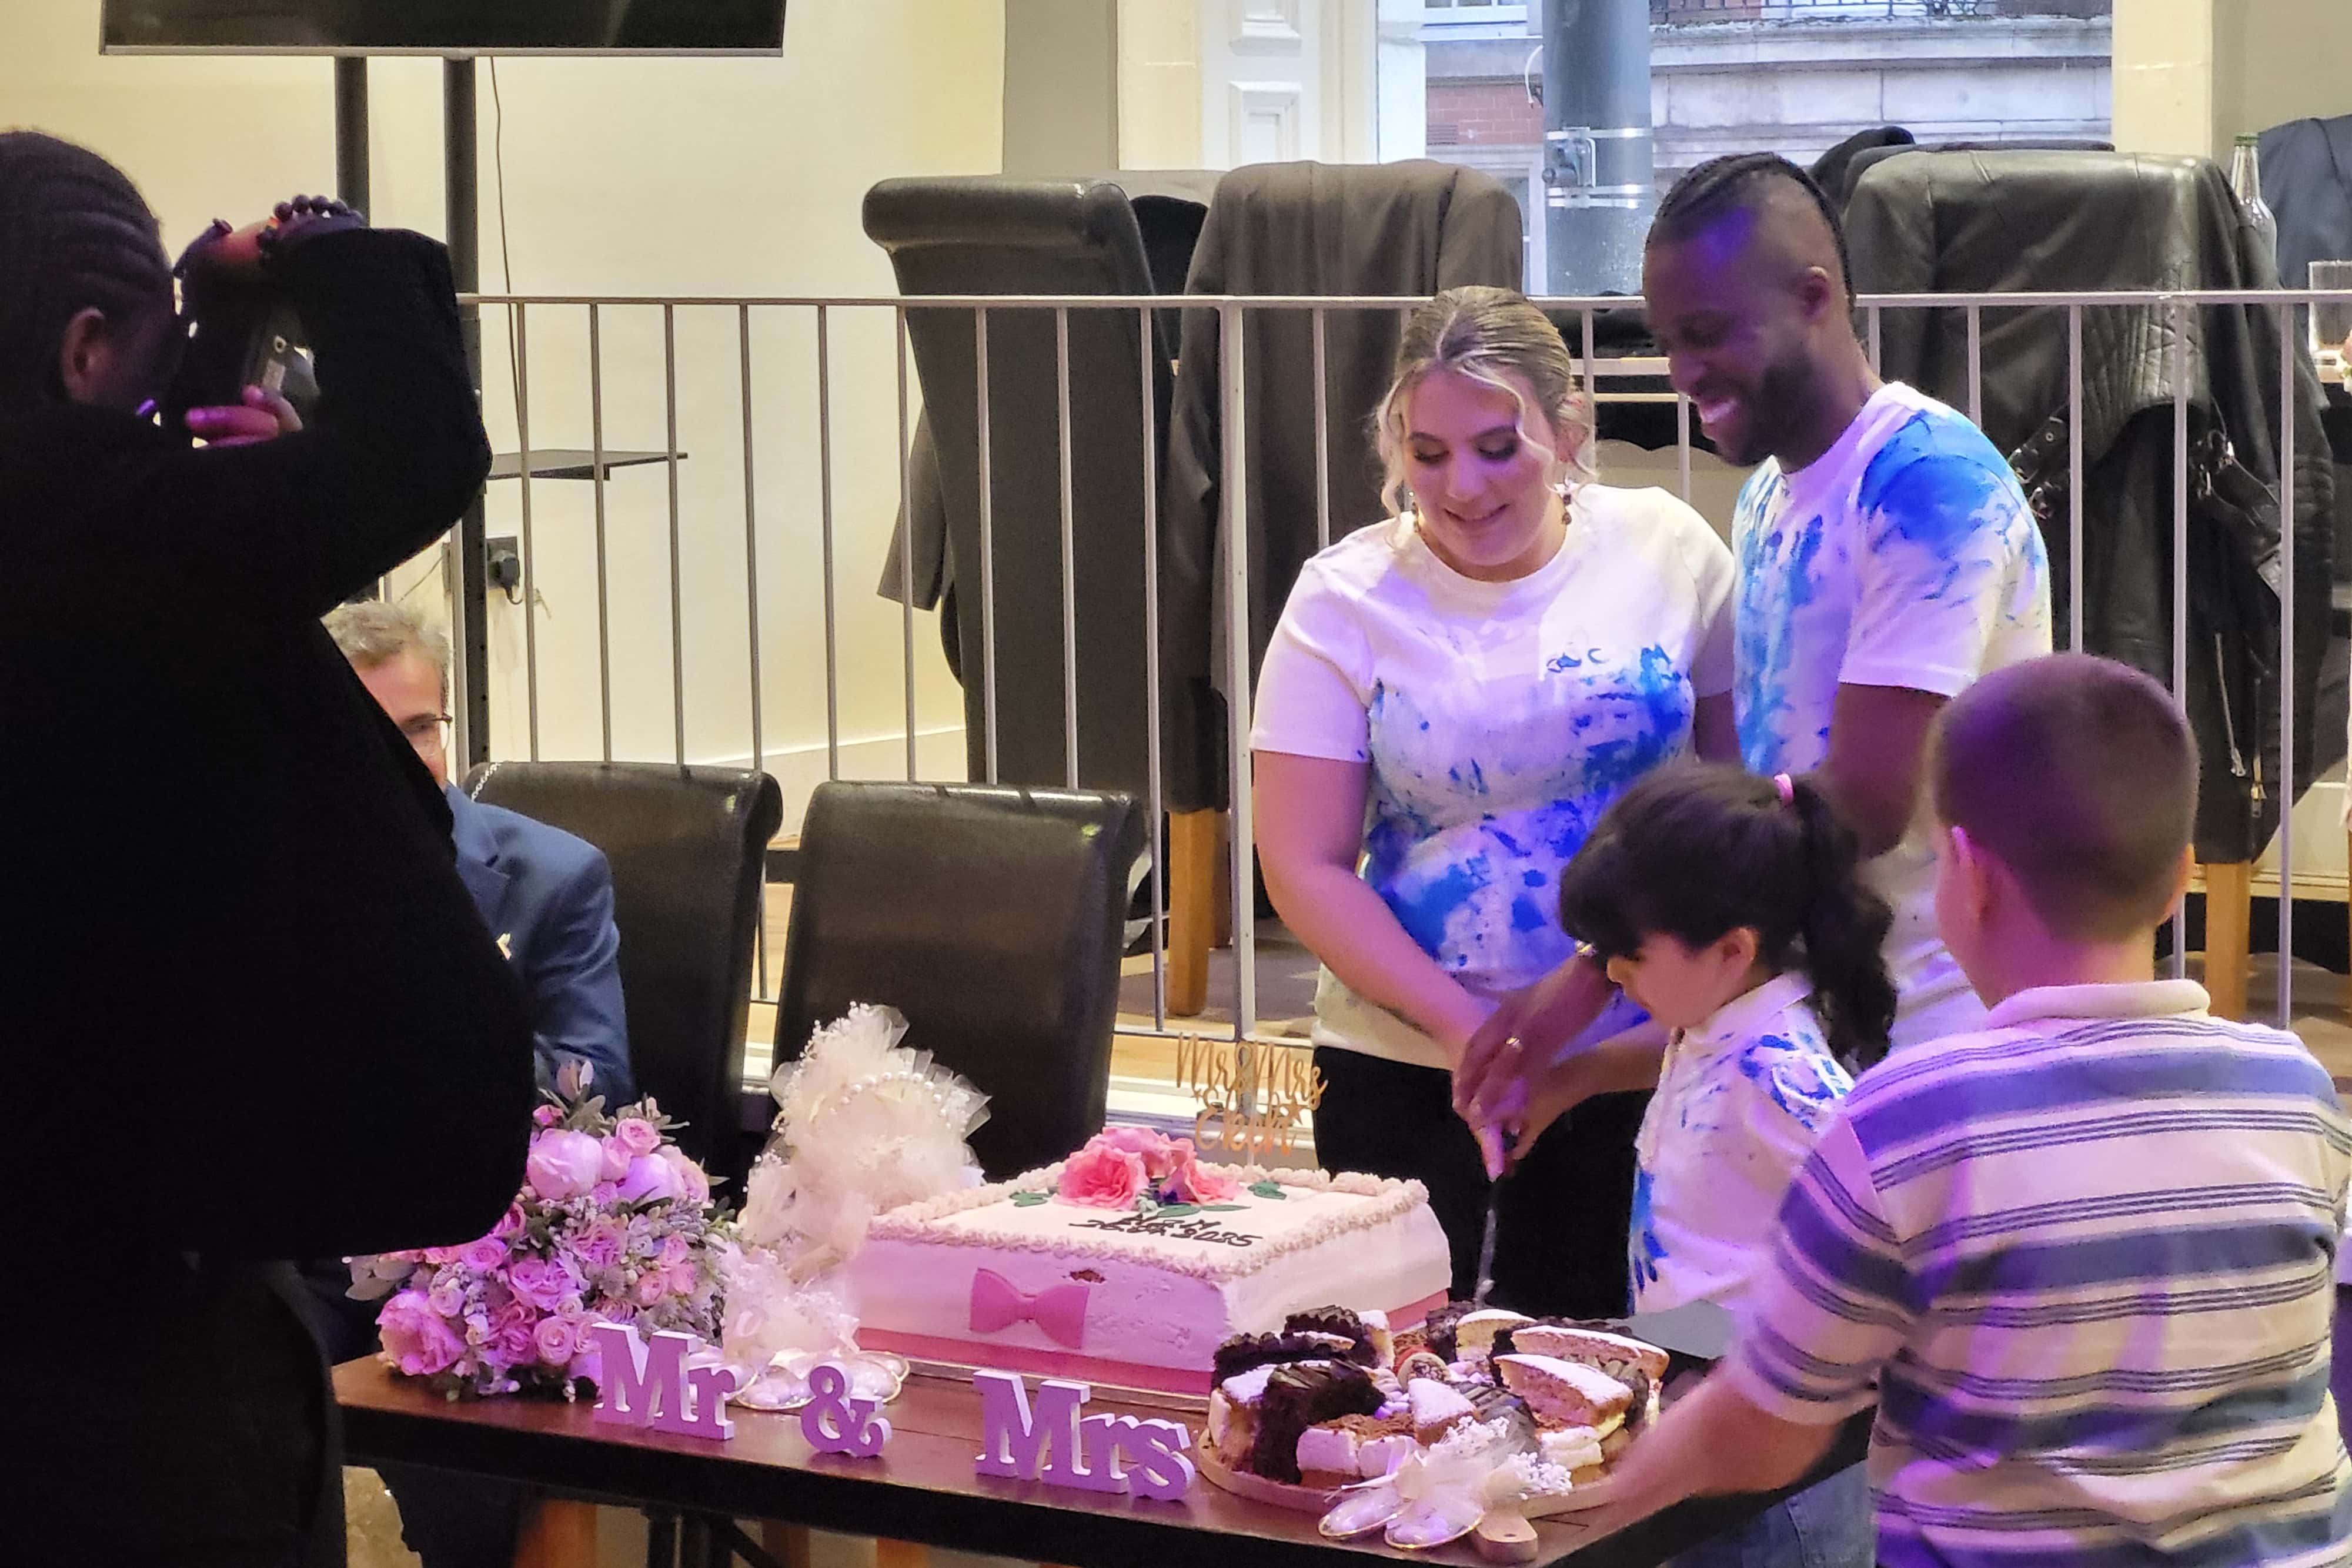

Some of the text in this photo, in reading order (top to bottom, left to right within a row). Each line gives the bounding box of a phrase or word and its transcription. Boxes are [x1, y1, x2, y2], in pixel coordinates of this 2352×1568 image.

[1176, 1032, 1233, 1092] Mr
[1251, 1040, 1329, 1111] Mrs
[590, 1322, 1195, 1501] Mr & Mrs
